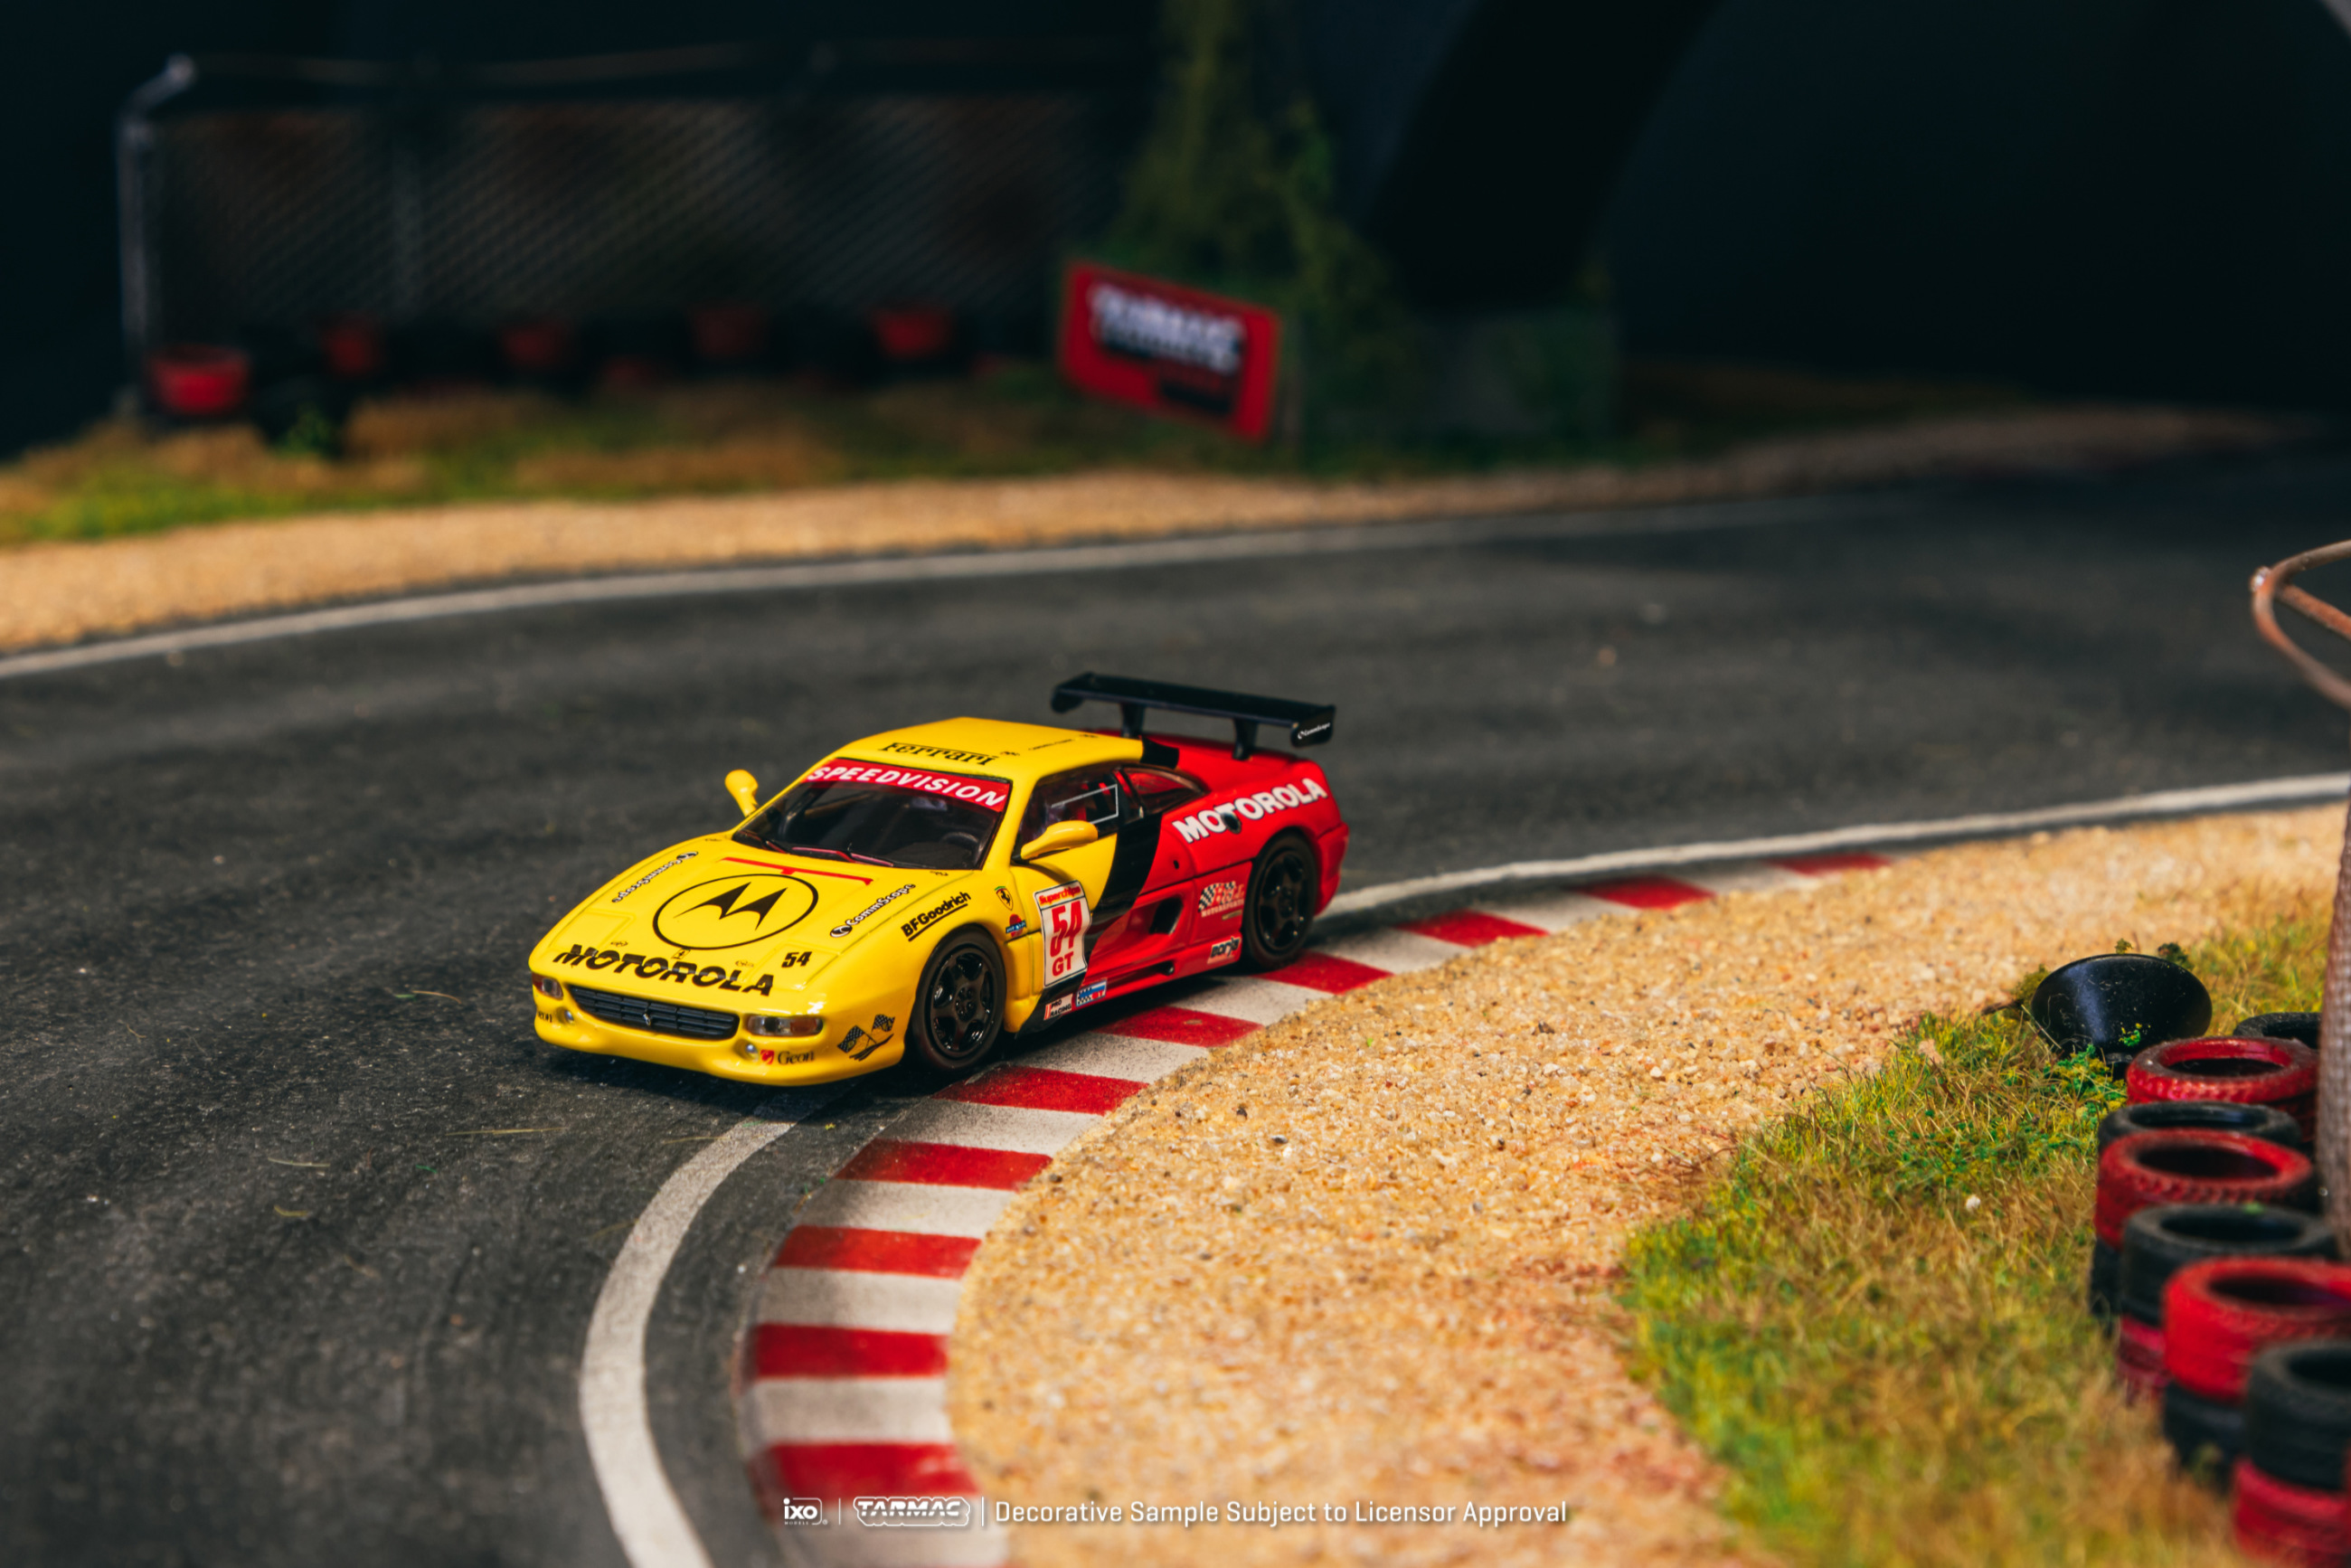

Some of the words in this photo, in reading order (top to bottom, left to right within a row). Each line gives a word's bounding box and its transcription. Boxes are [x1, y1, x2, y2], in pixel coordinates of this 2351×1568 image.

[879, 741, 998, 766] Ferrari
[807, 766, 1006, 807] SPEEDVISION
[1172, 778, 1329, 844] MOTOROLA
[845, 883, 916, 926] CommScope
[901, 892, 972, 939] BFGoodrich
[1050, 900, 1082, 958] 54
[552, 943, 774, 997] MOTOROLA
[781, 950, 813, 968] 54
[1052, 950, 1074, 978] GT
